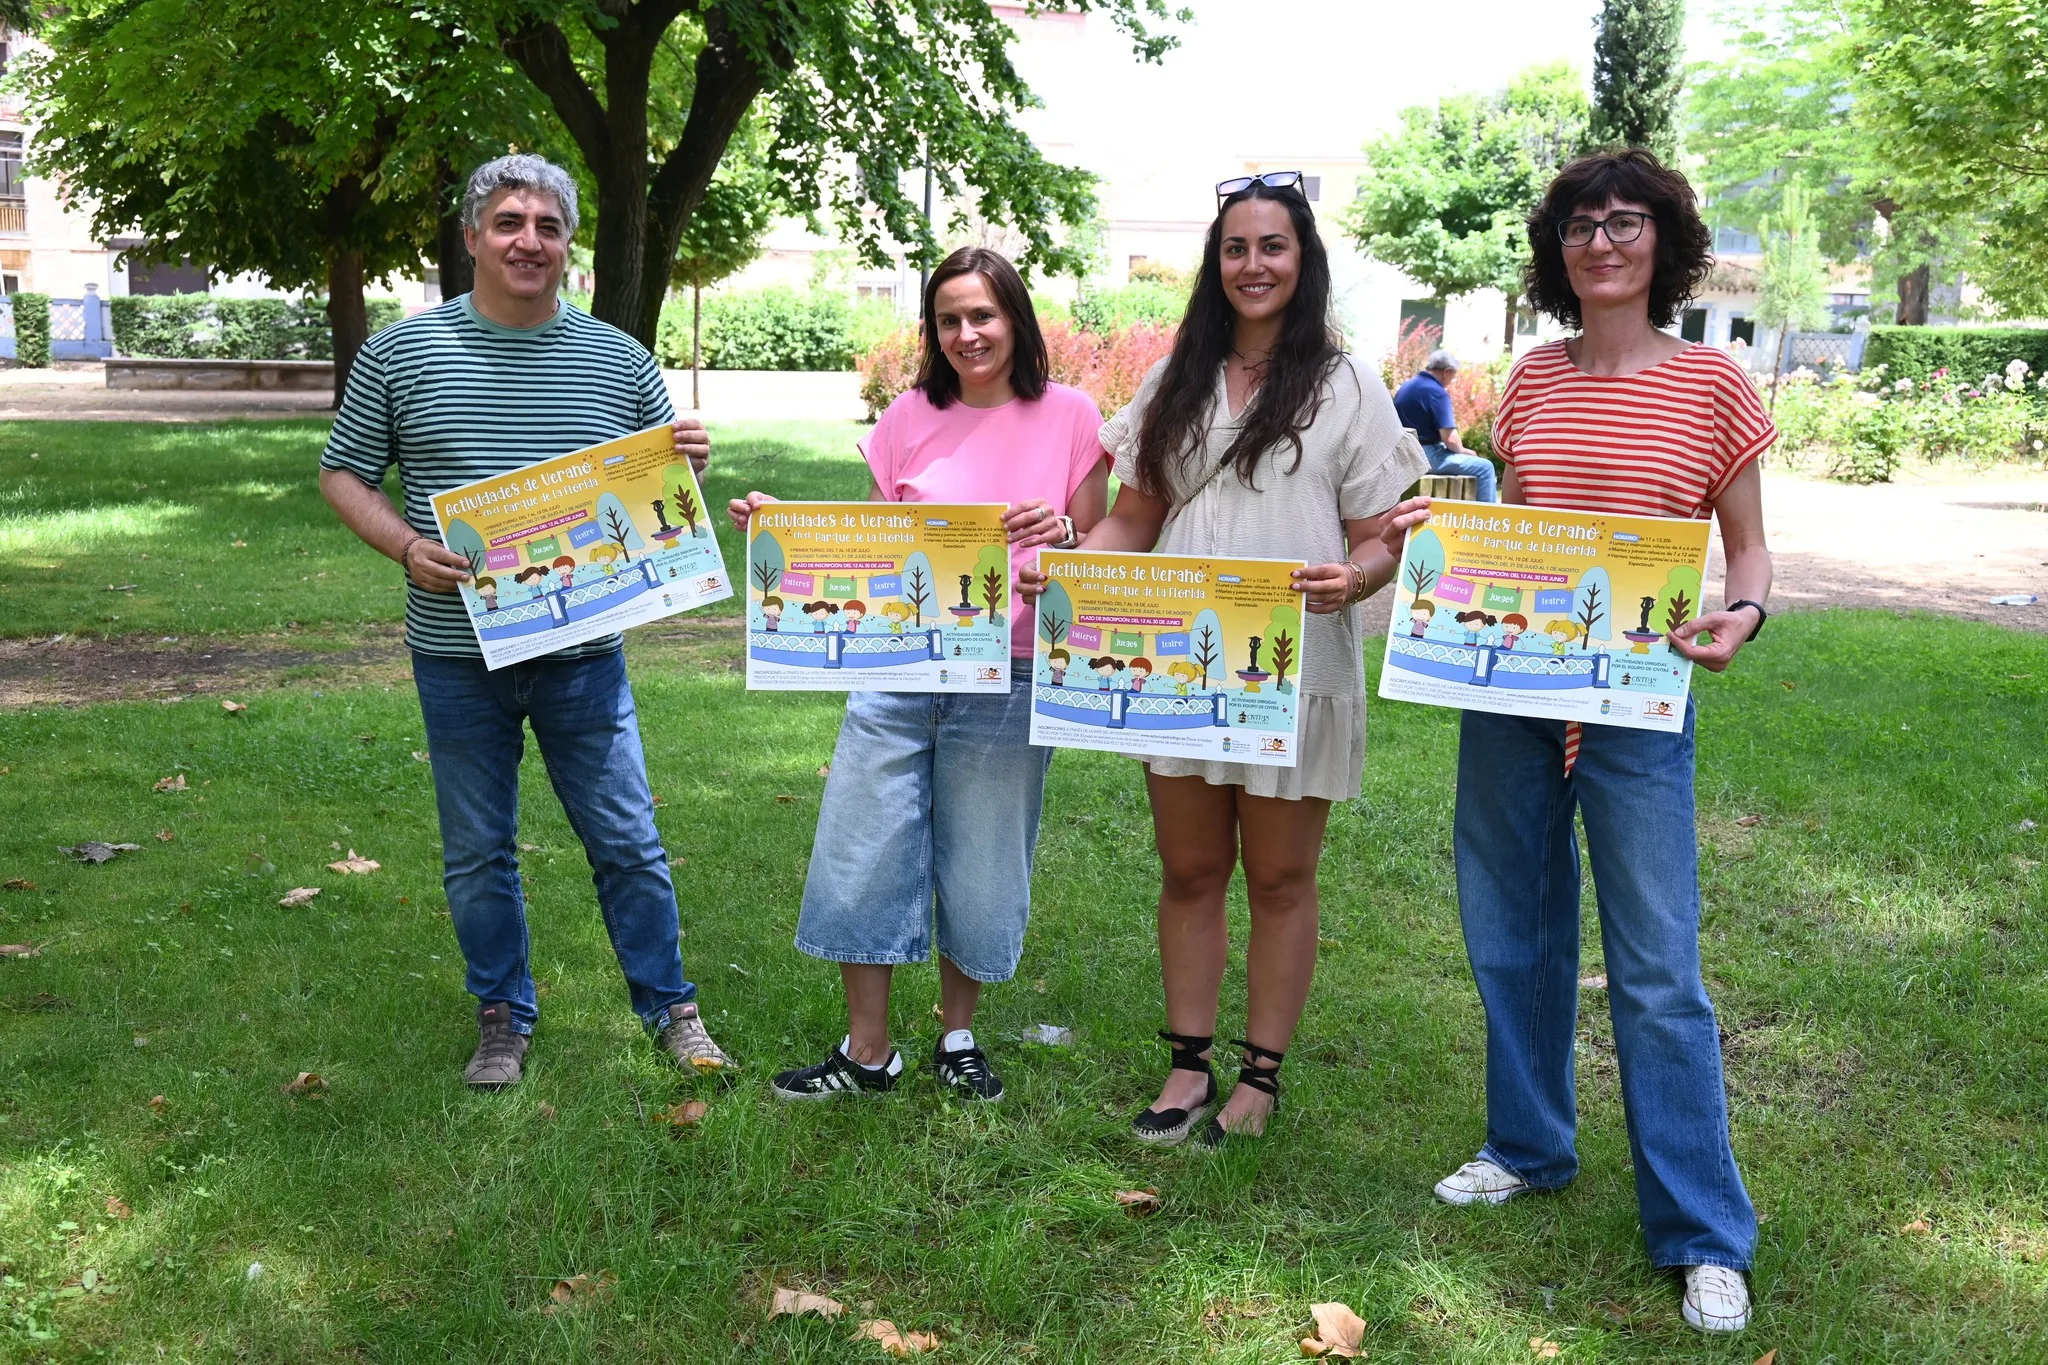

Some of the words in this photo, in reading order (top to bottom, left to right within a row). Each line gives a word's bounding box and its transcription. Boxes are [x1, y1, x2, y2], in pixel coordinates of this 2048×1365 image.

[446, 483, 520, 516] Actividades
[523, 478, 539, 491] de
[541, 461, 592, 486] Verano
[541, 493, 550, 502] de
[564, 478, 598, 495] Florida
[759, 513, 836, 527] Actividades
[841, 514, 856, 527] de
[861, 514, 914, 528] Verano
[1515, 520, 1533, 534] de
[1539, 521, 1600, 540] Verano
[854, 533, 863, 542] de
[880, 533, 913, 542] Florida
[1527, 542, 1538, 551] de
[1556, 544, 1596, 556] Florida
[1049, 562, 1126, 579] Actividades
[1131, 566, 1146, 580] de
[1151, 567, 1206, 583] Verano
[785, 579, 809, 587] talleres
[1441, 582, 1468, 595] talleres
[1144, 587, 1153, 596] de
[1169, 588, 1204, 599] Florida
[1489, 593, 1514, 603] juegos
[1072, 631, 1096, 642] talleres
[1115, 639, 1137, 648] juegos
